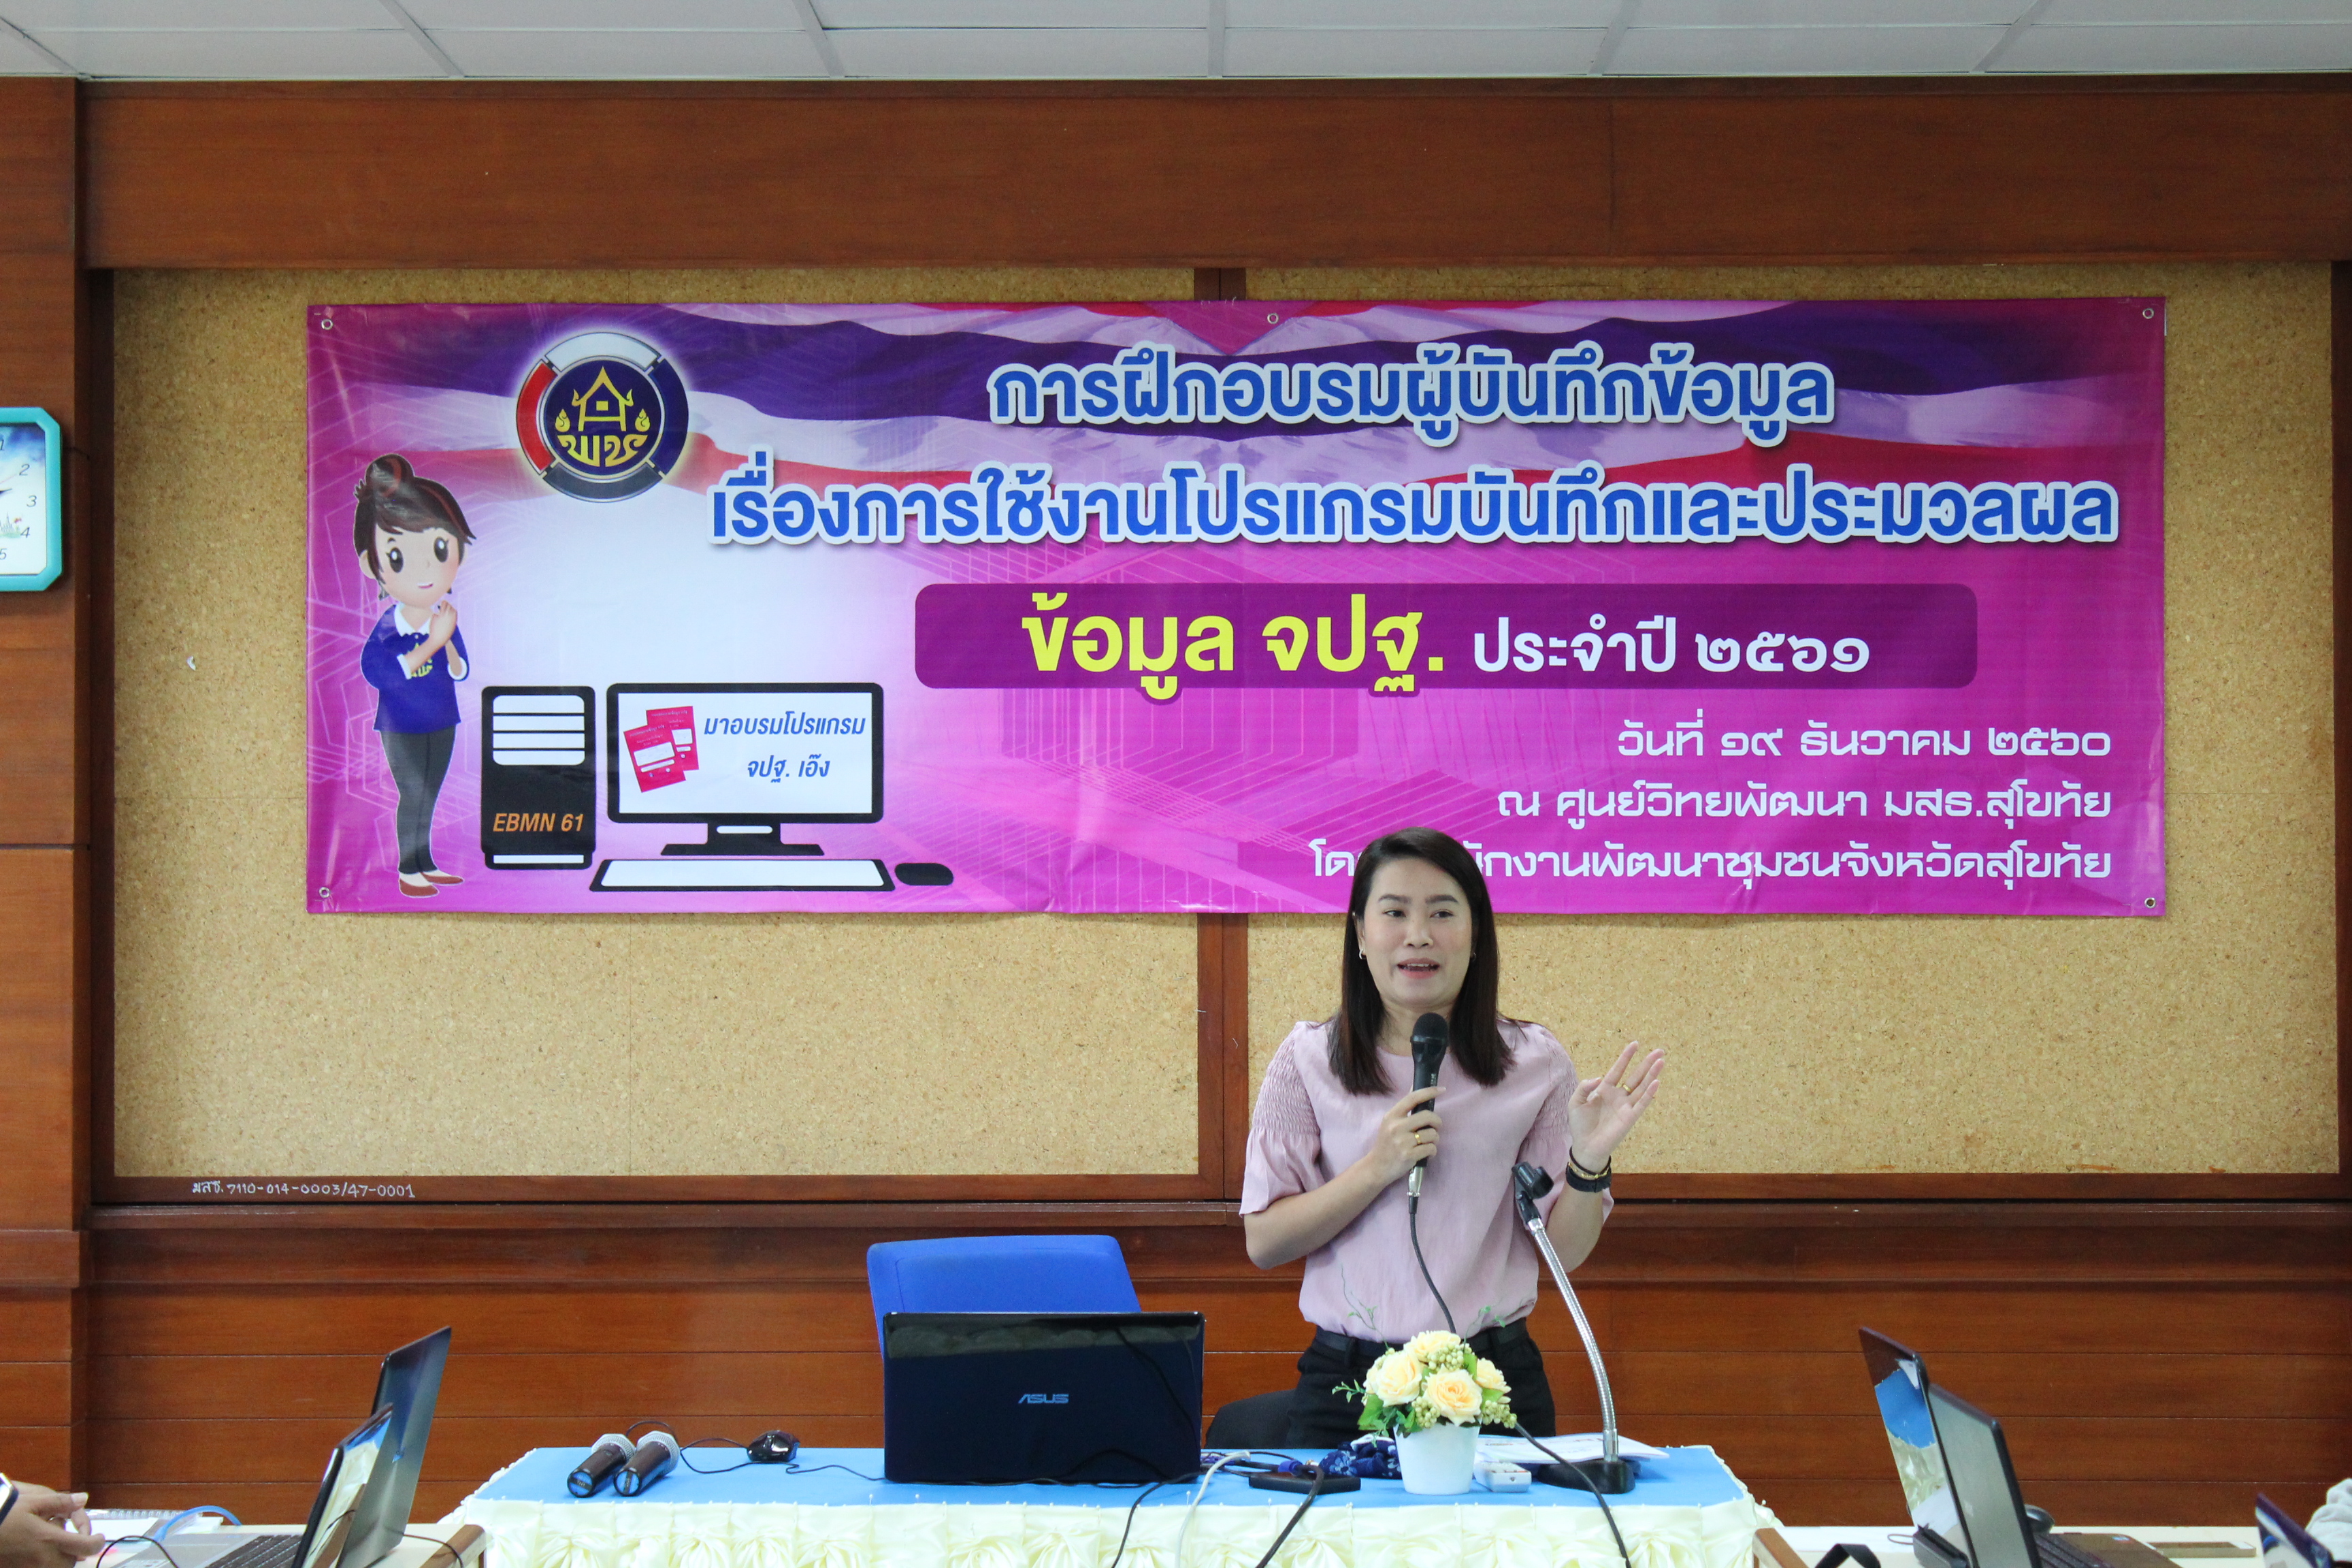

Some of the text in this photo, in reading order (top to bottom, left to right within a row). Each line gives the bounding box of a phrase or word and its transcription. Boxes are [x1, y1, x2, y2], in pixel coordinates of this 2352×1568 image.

[991, 344, 1831, 444] การฝึกอบรมผู้บันทึกข้อมูล
[18, 463, 31, 476] 2
[26, 495, 37, 508] 3
[712, 449, 2114, 540] เรื่องการใช้งานโปรแกรมบันทึกและประมวลผล
[20, 527, 31, 538] 4
[1022, 592, 1870, 700] ข้อมูล จปฐ. ประจำปี ๒๕๖๑
[704, 711, 866, 735] มาอบรมโปรแกรม
[1617, 708, 2111, 757] วันที่ ๑๙ ธันวาคม ๒๕๖๐
[747, 753, 830, 783] จปฐ. เอ๊ง
[1497, 779, 2111, 830] ณ ศูนย์วิทยพัฒนา มสธ.สุโขทัย
[492, 813, 583, 832] EBMN 61
[1307, 838, 1358, 877] โด
[227, 1181, 416, 1198] 7110-014-0003/47-0001
[1017, 1392, 1070, 1405] ASUS
